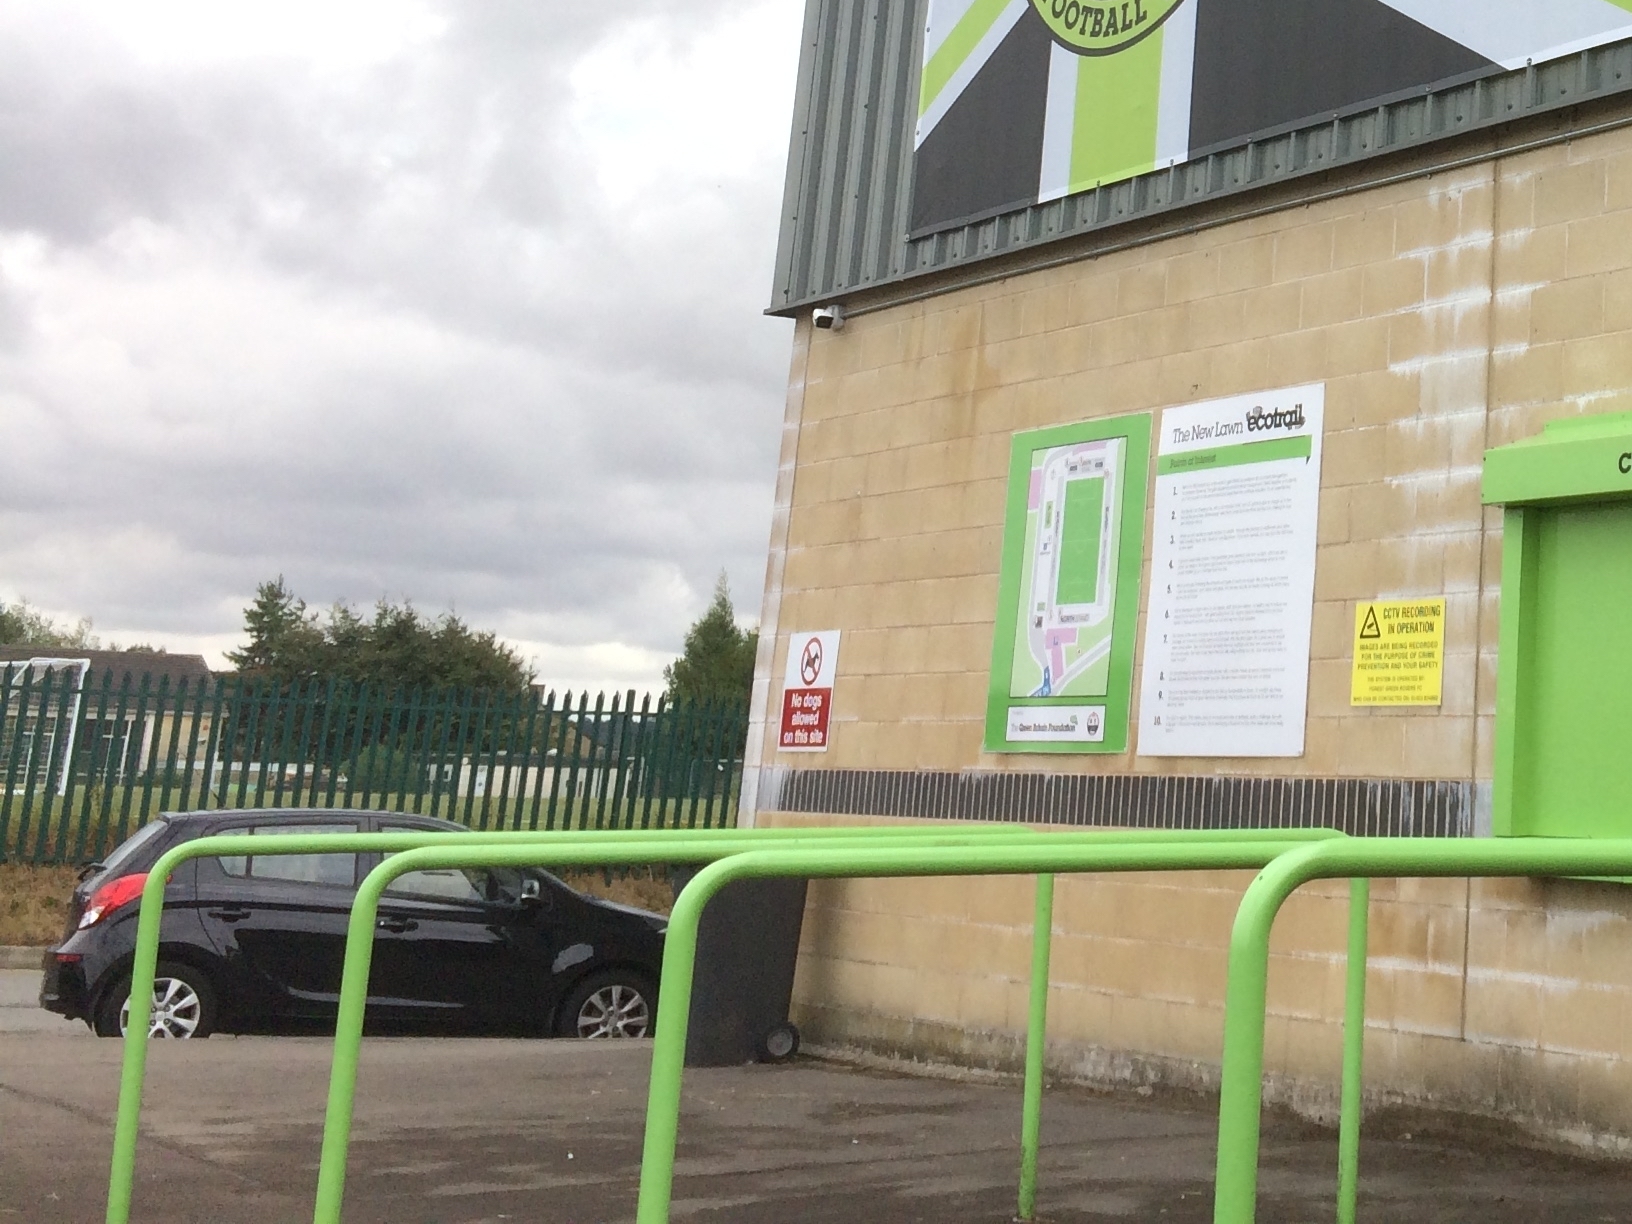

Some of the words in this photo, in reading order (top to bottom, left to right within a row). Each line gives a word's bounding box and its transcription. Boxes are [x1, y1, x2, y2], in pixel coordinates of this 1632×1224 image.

[1173, 427, 1190, 443] The
[1191, 424, 1214, 441] New
[1215, 421, 1244, 438] Lawn
[1247, 403, 1304, 432] ecotrail
[1383, 607, 1399, 619] CCTV
[1402, 605, 1441, 618] RECORDING
[1388, 623, 1395, 634] IN
[1396, 621, 1435, 634] OPERATION
[1358, 662, 1389, 670] PREVENTION
[791, 693, 802, 707] No
[804, 693, 822, 710] dogs
[792, 711, 819, 725] allowed
[783, 731, 793, 744] on
[795, 729, 808, 743] this
[810, 729, 823, 743] site
